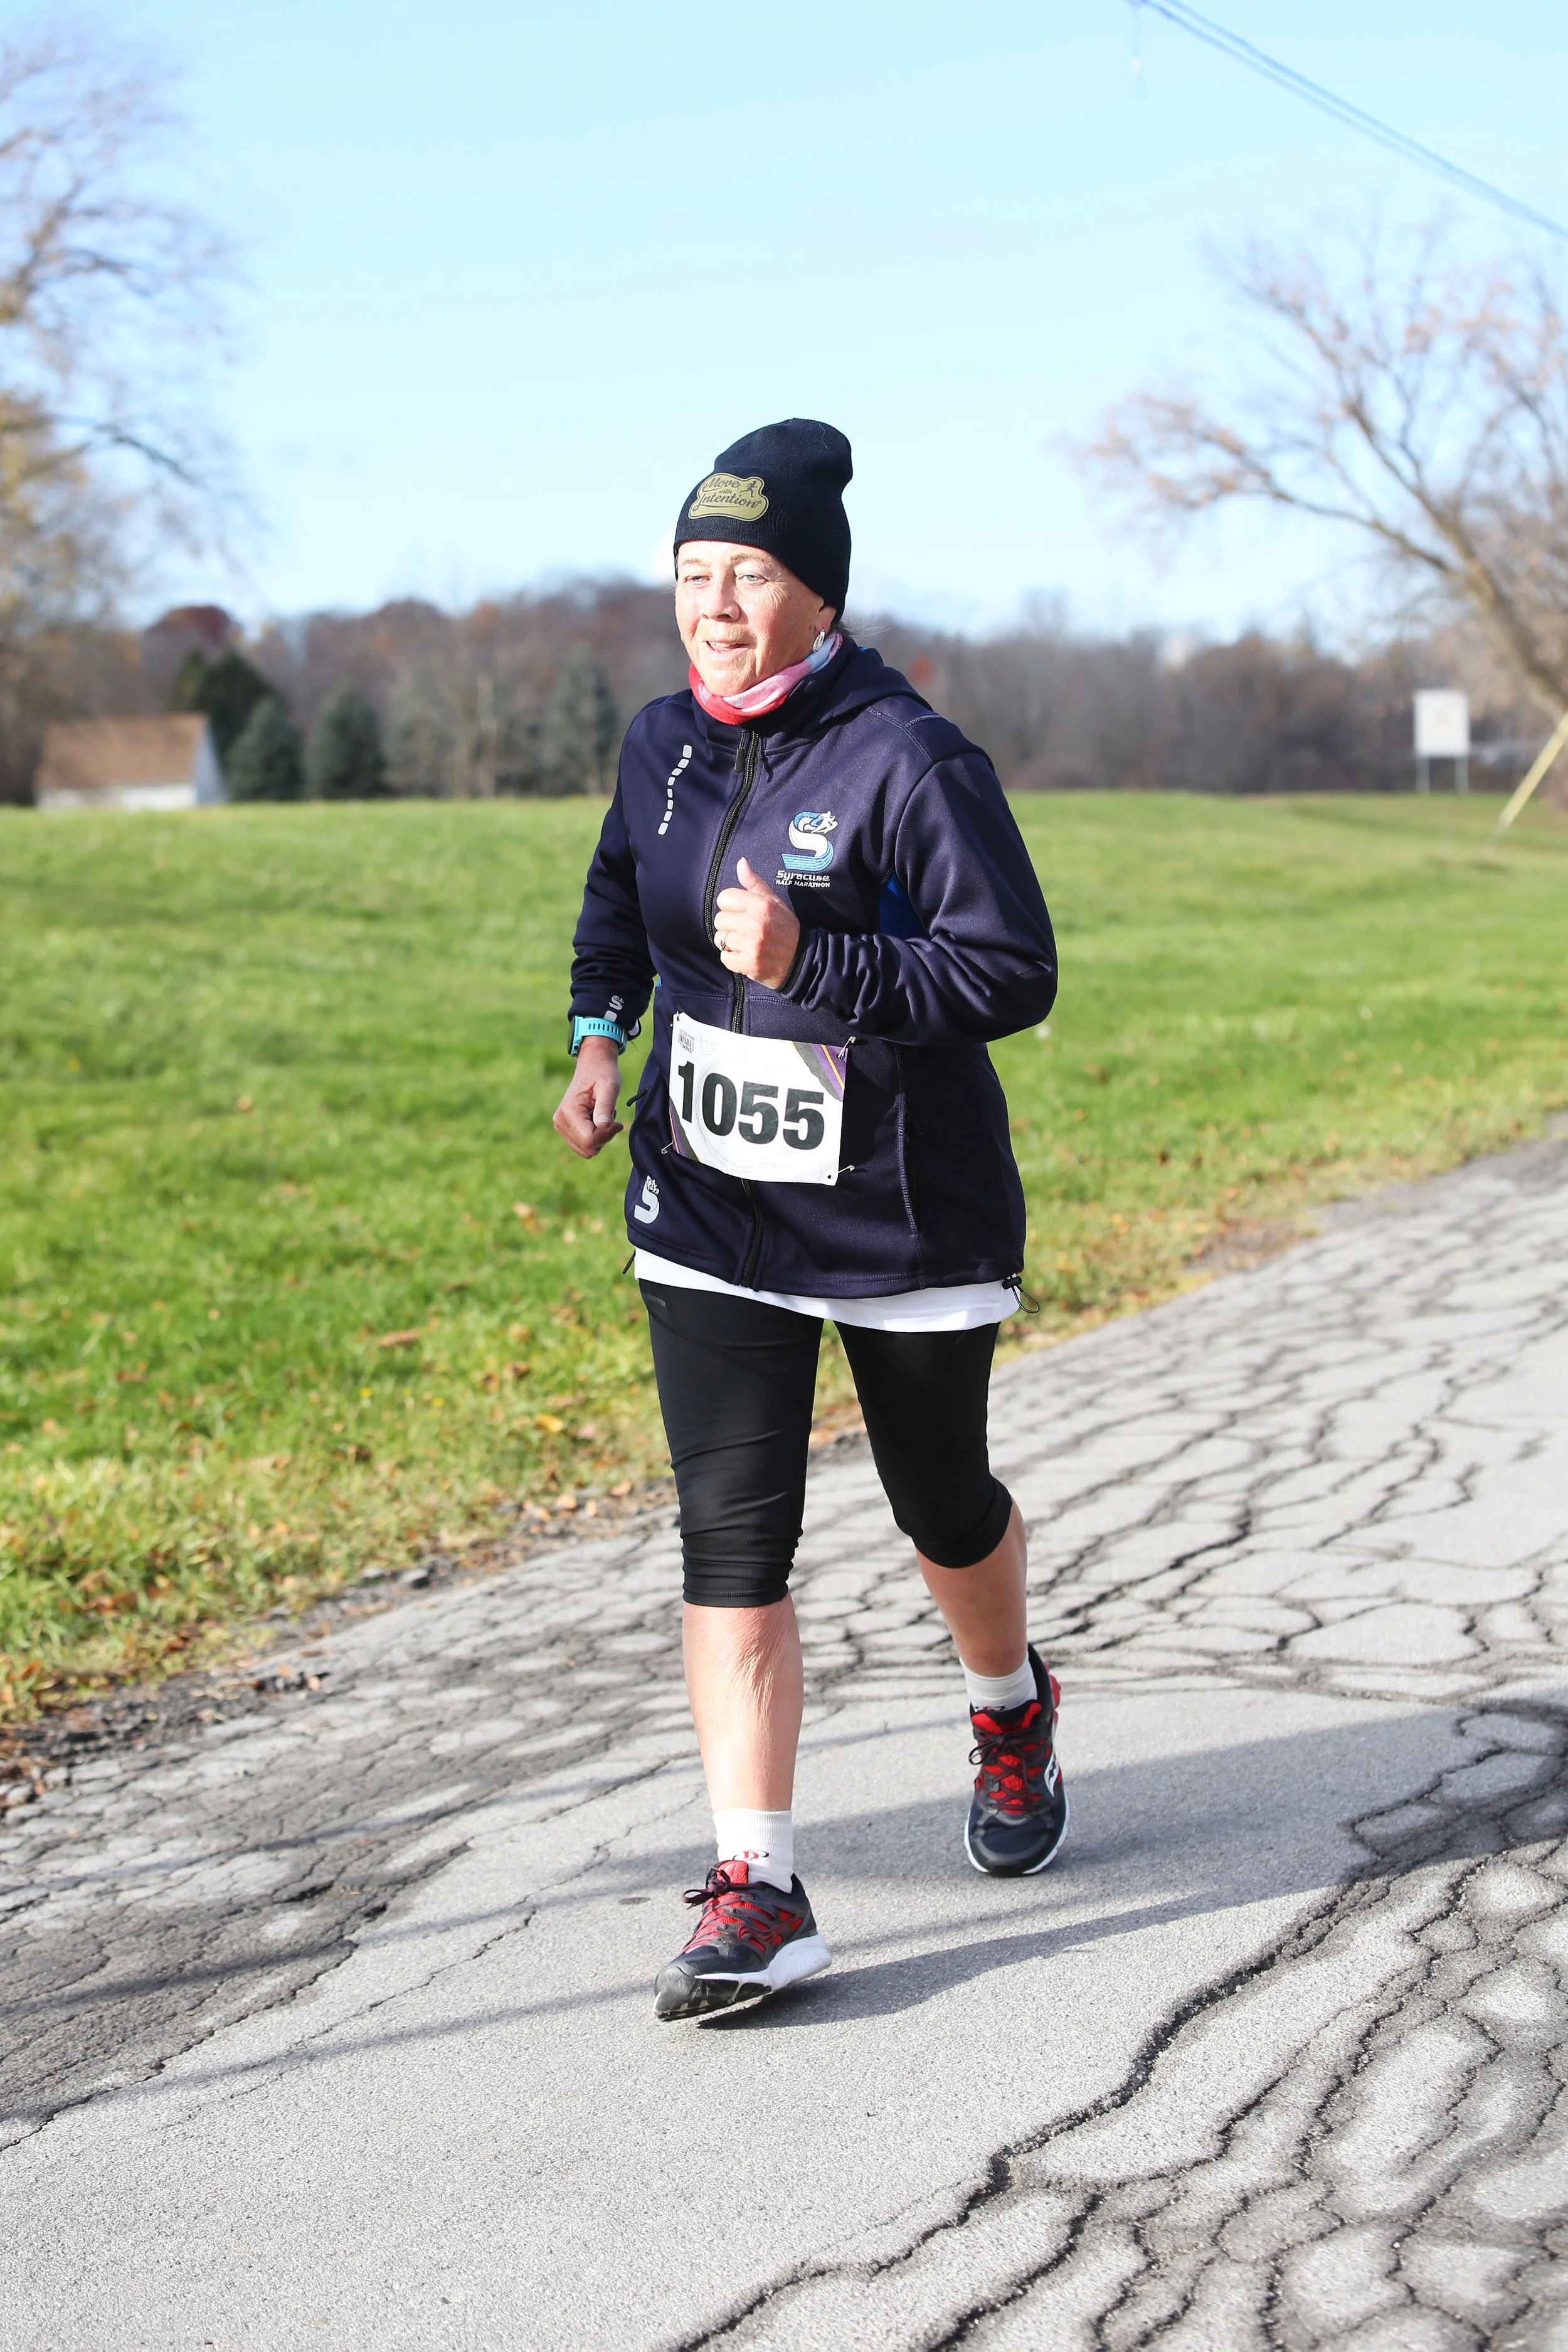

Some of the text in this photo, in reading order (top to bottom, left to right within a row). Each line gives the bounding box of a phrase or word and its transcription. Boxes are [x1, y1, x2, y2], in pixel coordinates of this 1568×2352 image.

[702, 477, 741, 492] Move
[692, 493, 761, 511] Intention
[776, 870, 830, 881] Syracuse
[678, 1061, 824, 1150] 1055
